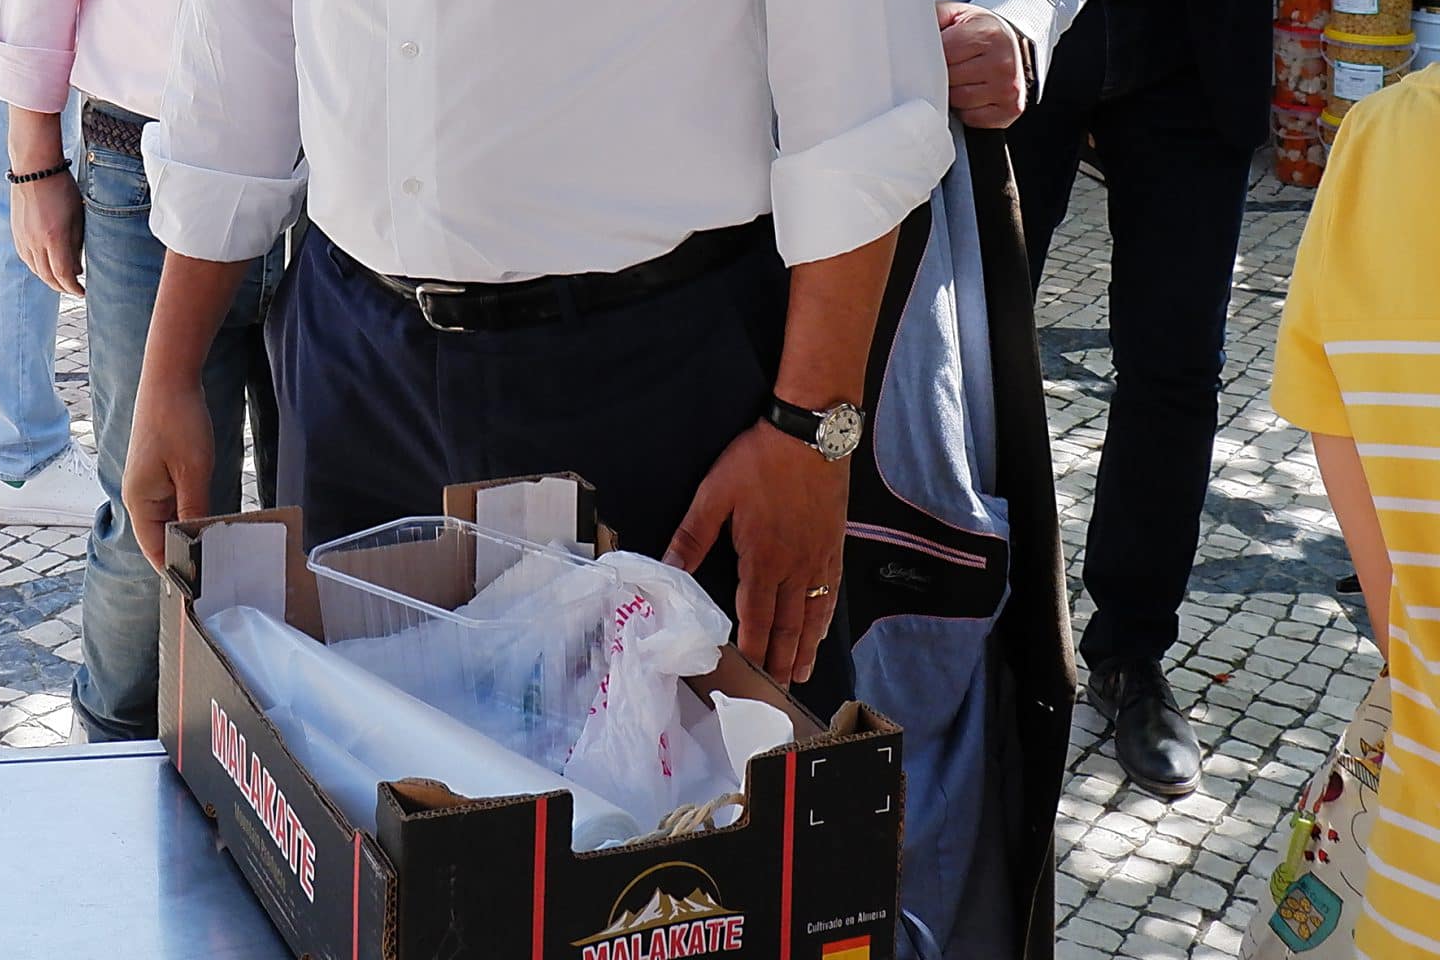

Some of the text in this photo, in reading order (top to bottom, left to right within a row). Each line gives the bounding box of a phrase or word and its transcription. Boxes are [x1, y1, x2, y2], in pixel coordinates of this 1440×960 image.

[212, 698, 316, 903] MALAKATE
[807, 918, 843, 935] Cultivado
[845, 916, 855, 926] en
